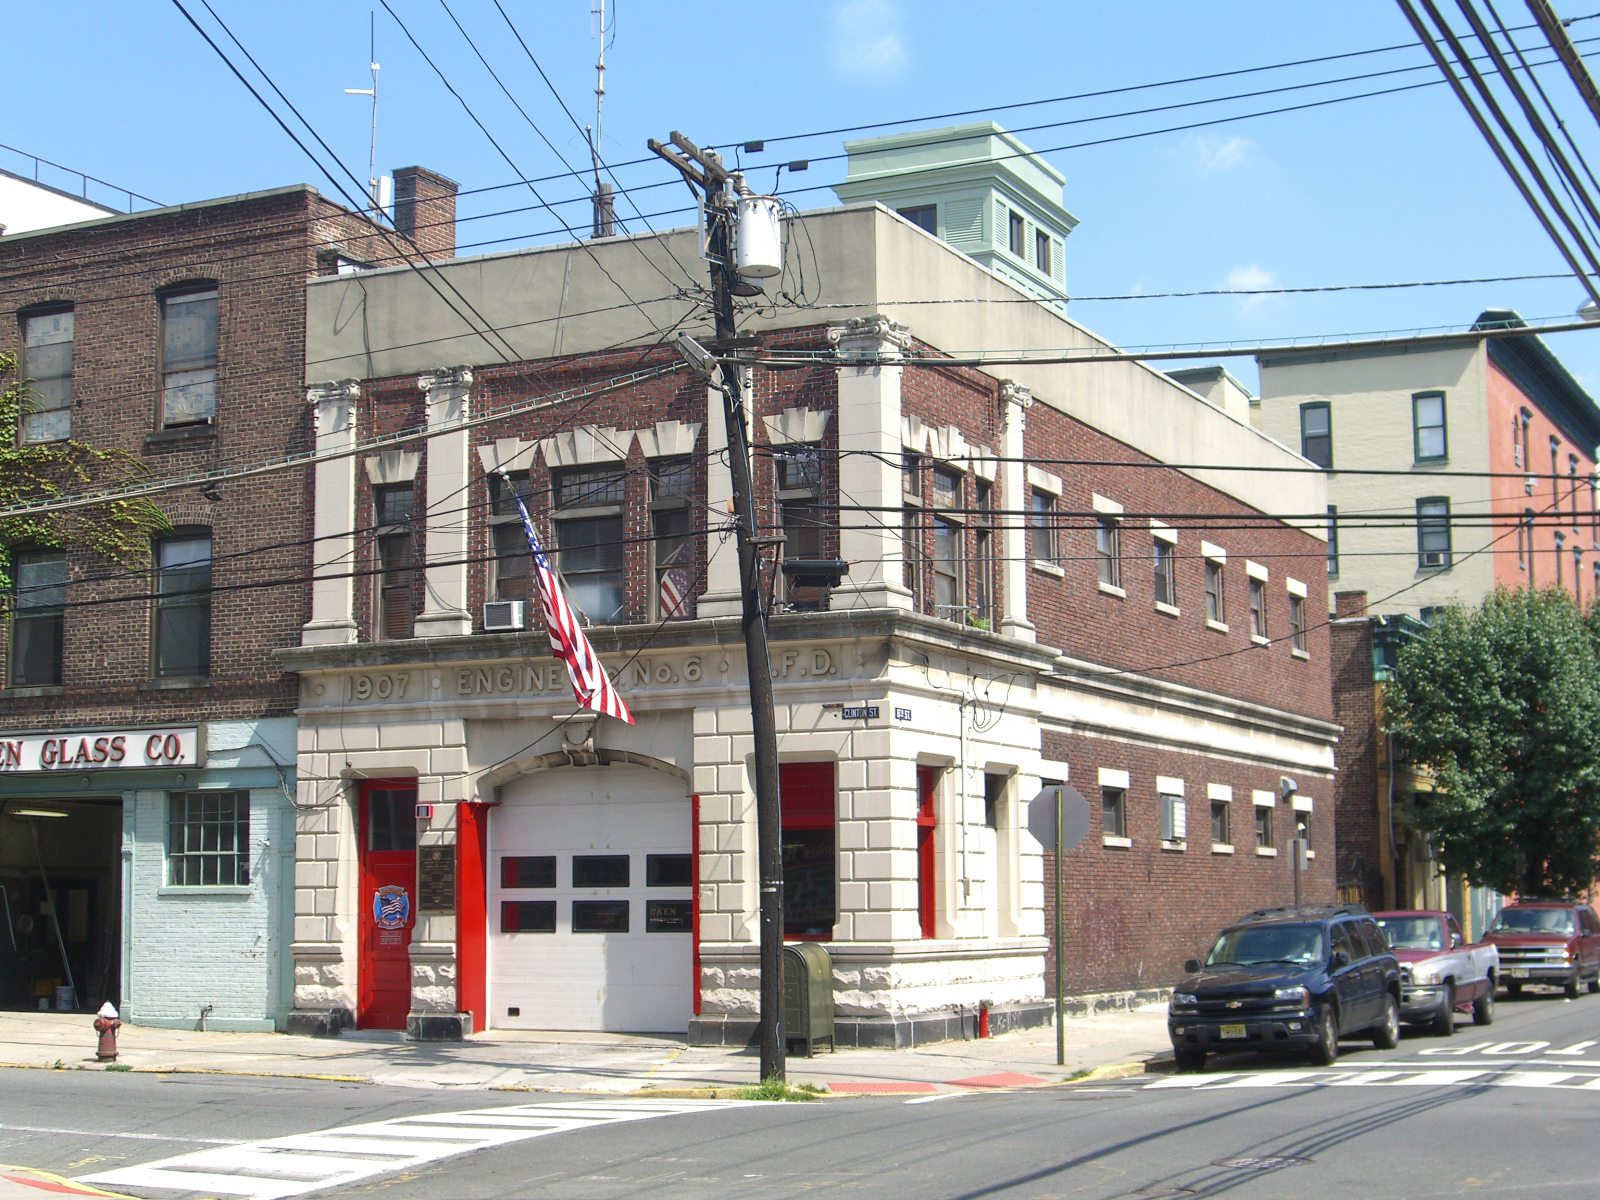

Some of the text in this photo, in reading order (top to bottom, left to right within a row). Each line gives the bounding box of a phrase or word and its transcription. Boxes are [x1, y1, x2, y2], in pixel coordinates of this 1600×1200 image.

[346, 673, 409, 700] 1907
[457, 665, 563, 694] ENGINE
[844, 708, 867, 719] CLINTON
[41, 736, 126, 764] GLASS
[146, 733, 185, 760] CO.
